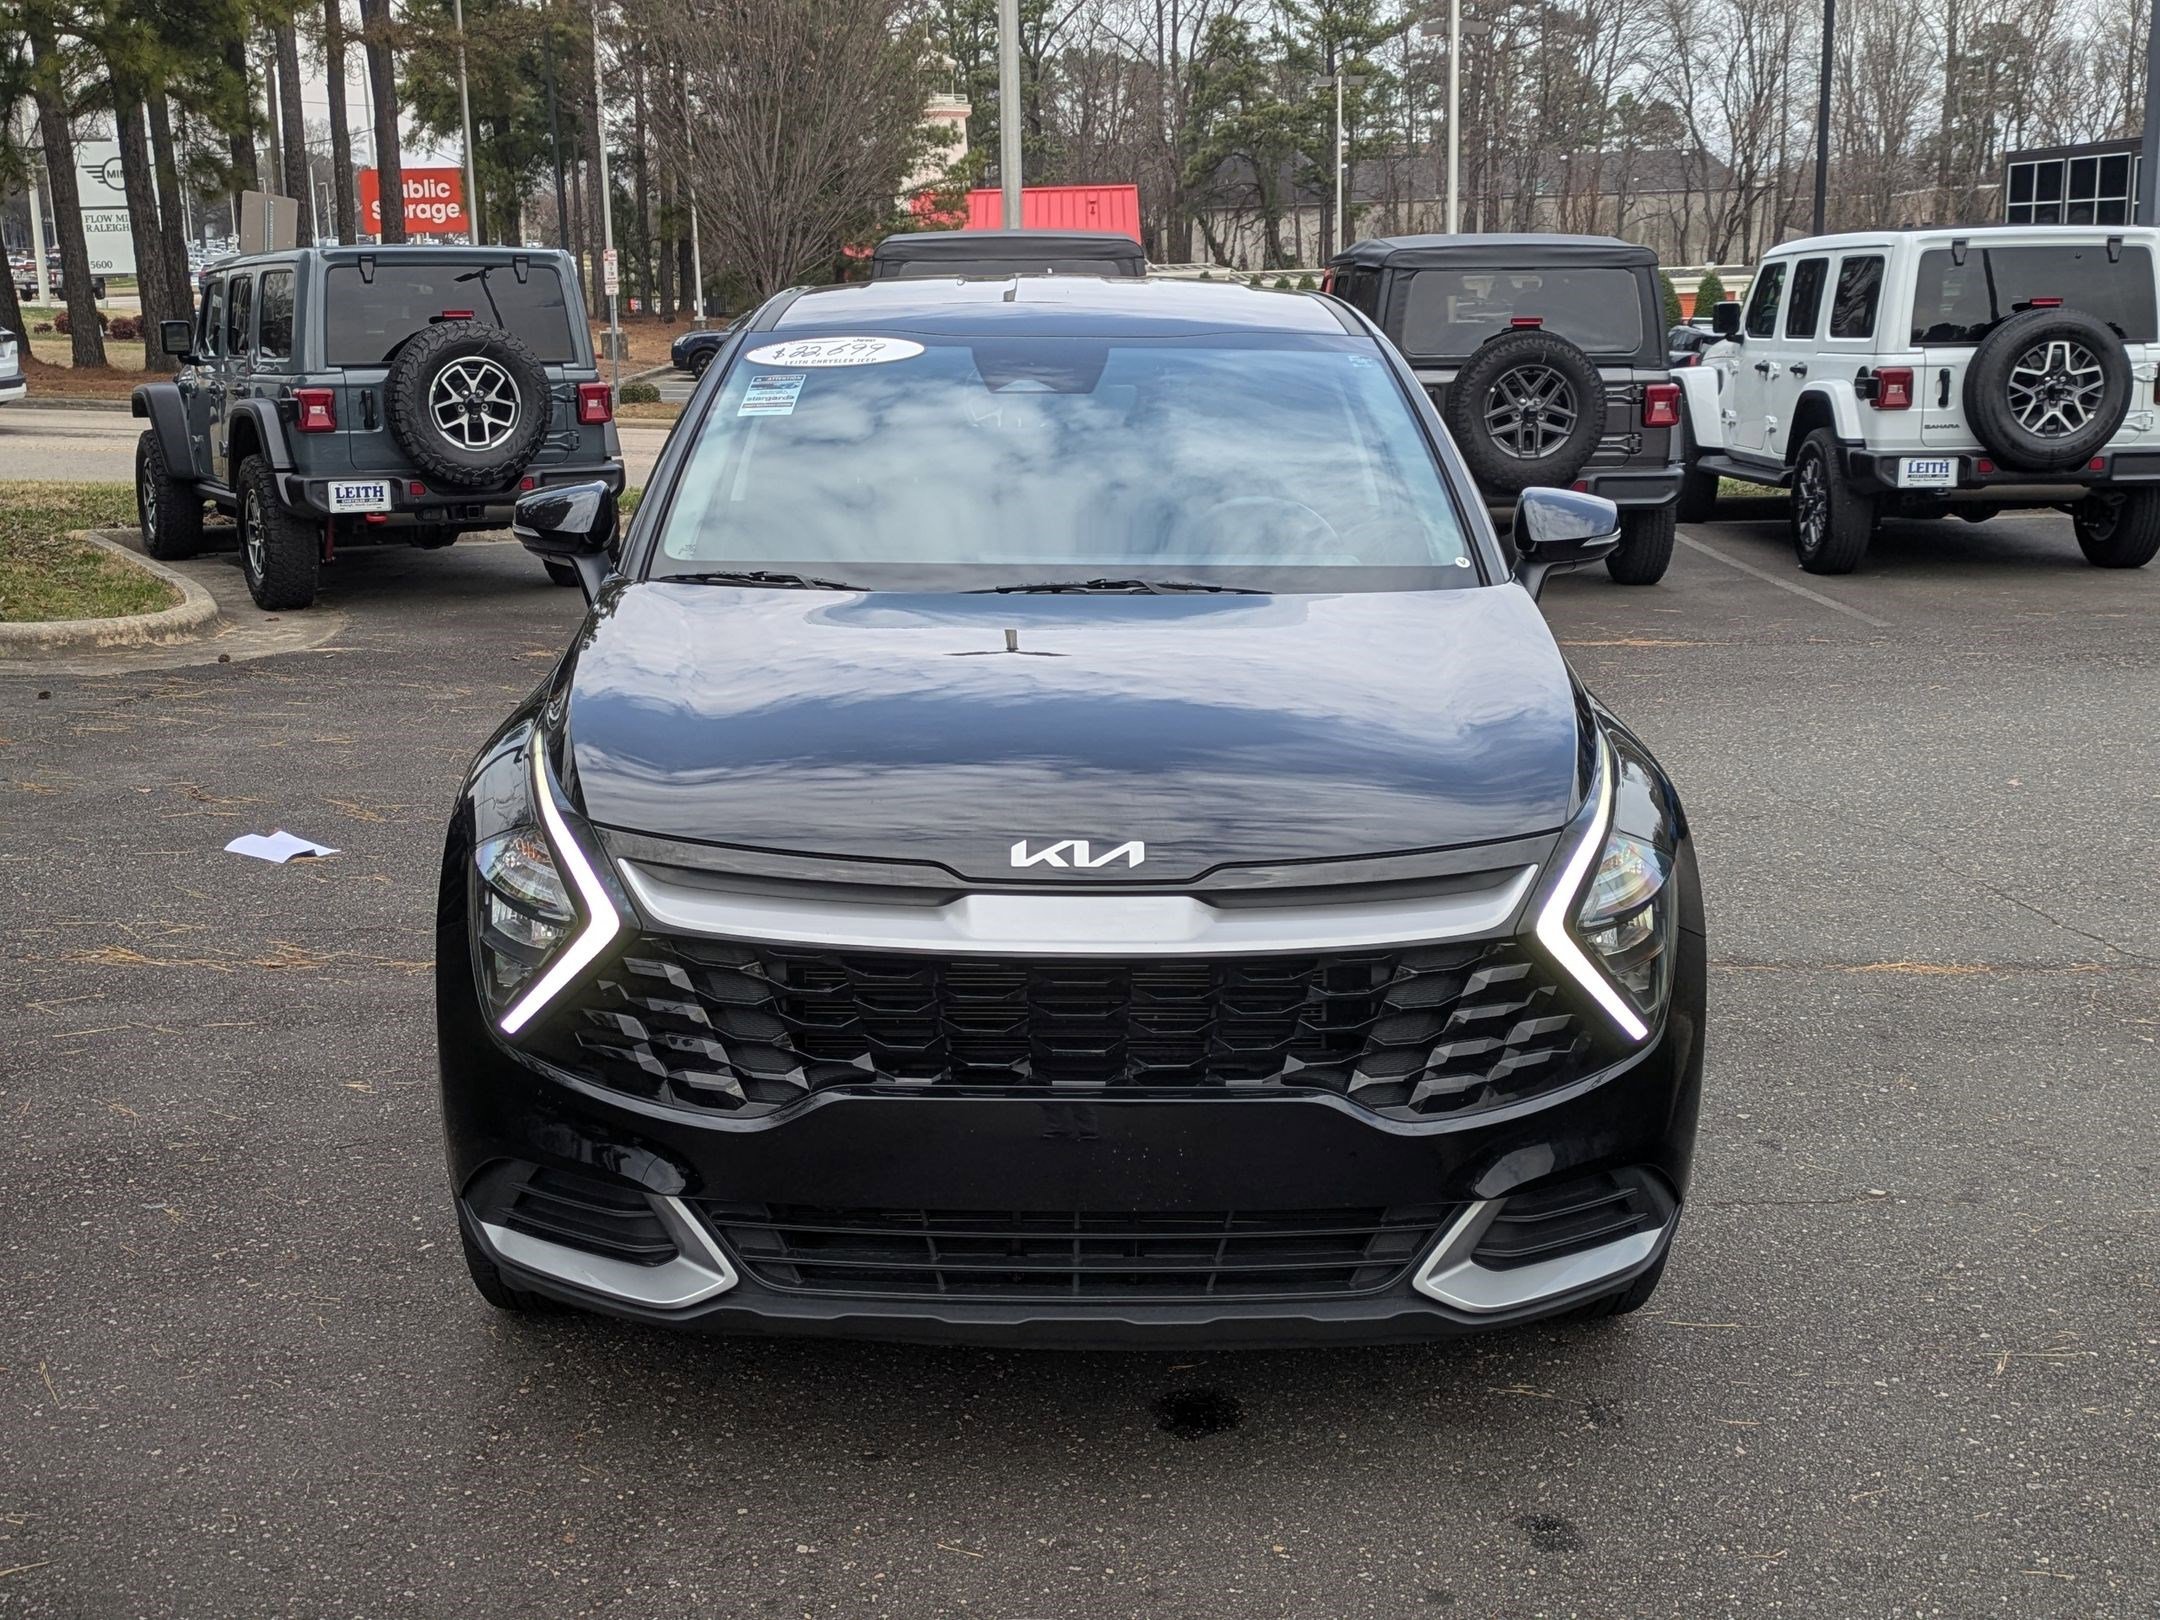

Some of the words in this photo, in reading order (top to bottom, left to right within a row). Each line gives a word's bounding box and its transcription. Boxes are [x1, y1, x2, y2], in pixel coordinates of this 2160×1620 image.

[371, 200, 460, 224] Srage
[85, 214, 113, 223] FLOW
[86, 223, 130, 233] RALEIGH
[90, 260, 113, 269] 5600
[1907, 462, 1950, 473] LEITH
[334, 485, 385, 499] LEITH
[1010, 839, 1146, 869] KIA
